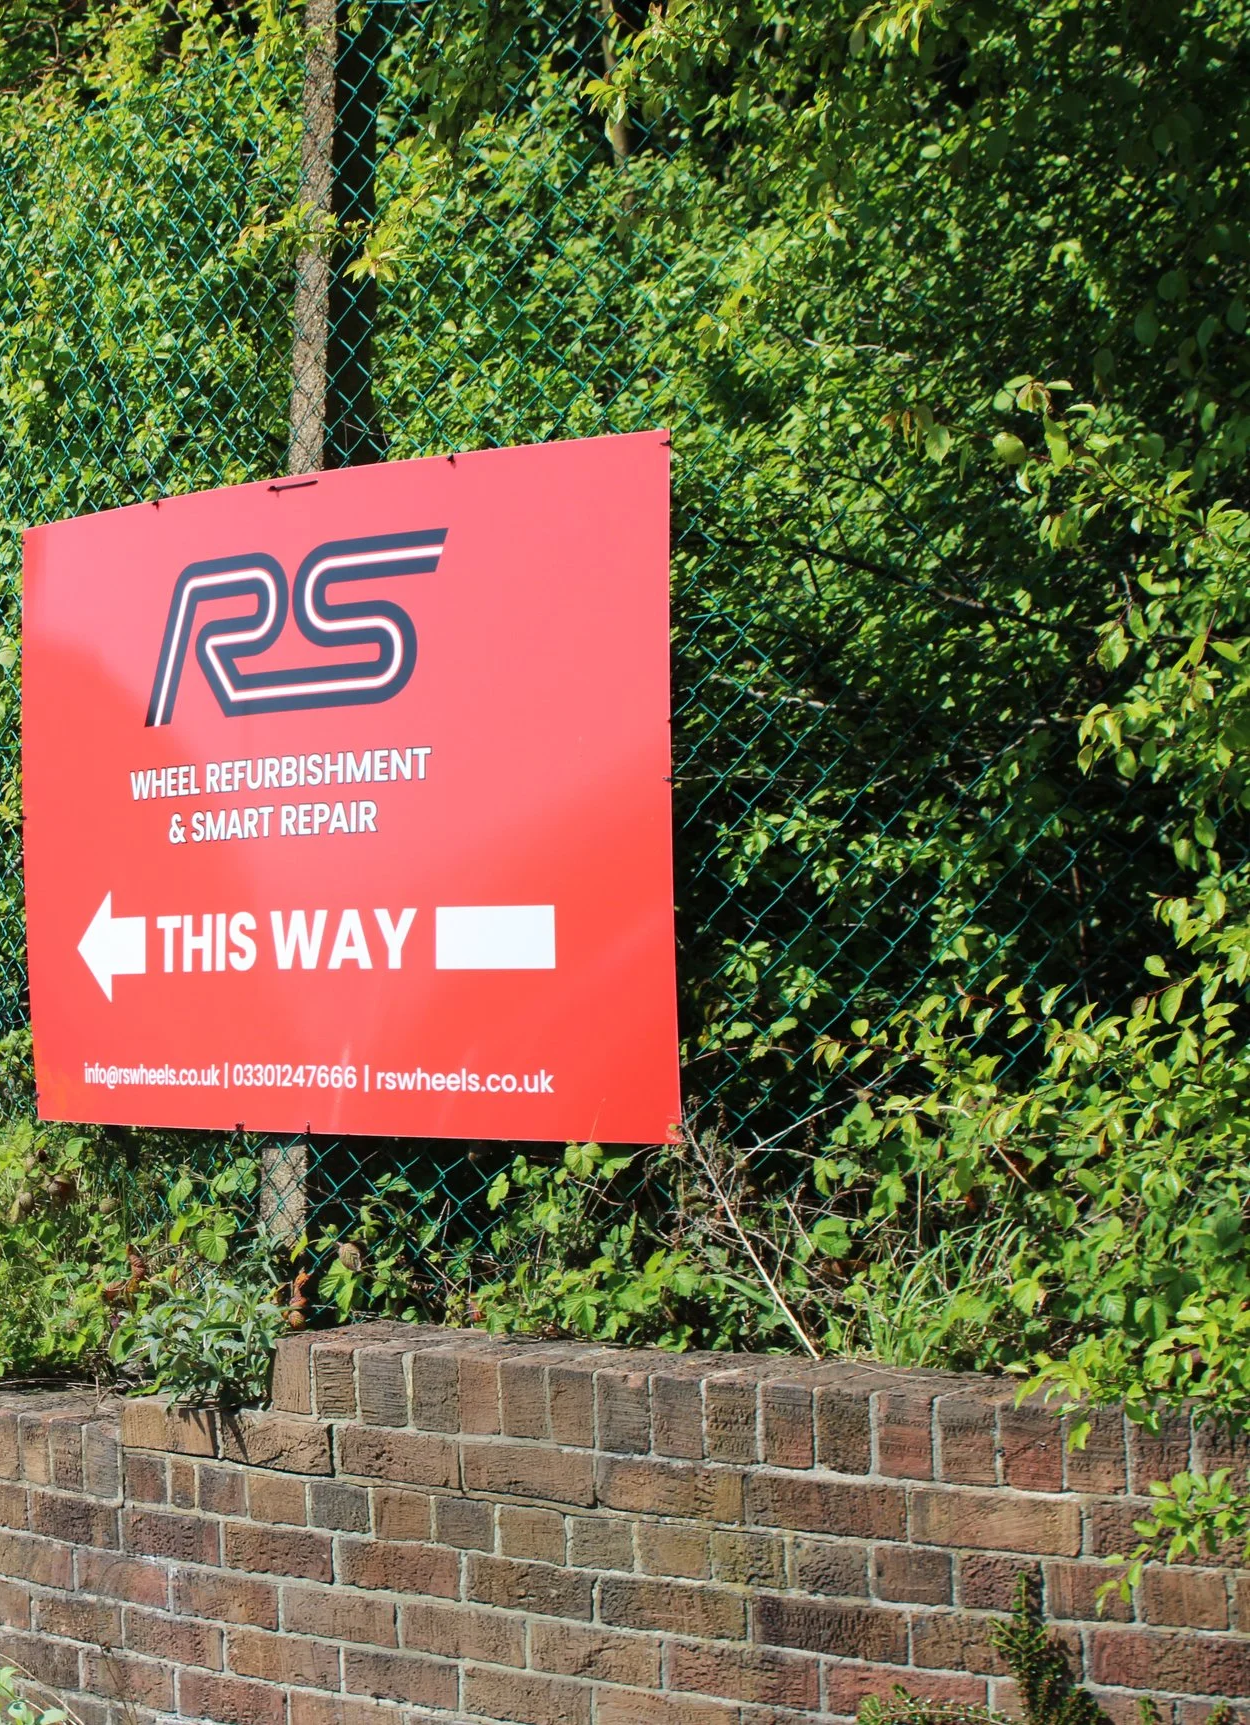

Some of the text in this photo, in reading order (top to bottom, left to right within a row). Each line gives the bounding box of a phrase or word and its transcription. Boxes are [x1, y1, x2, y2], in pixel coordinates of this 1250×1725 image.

[144, 527, 449, 728] RS
[129, 746, 432, 801] WHEEL REFURBISHMENT
[168, 799, 378, 844] & SMART REPAIR
[156, 907, 418, 974] THIS WAY
[83, 1062, 220, 1090] info@rswheels.co.uk
[232, 1062, 358, 1090] 03301247666
[375, 1067, 555, 1094] rswheels.co.uk
